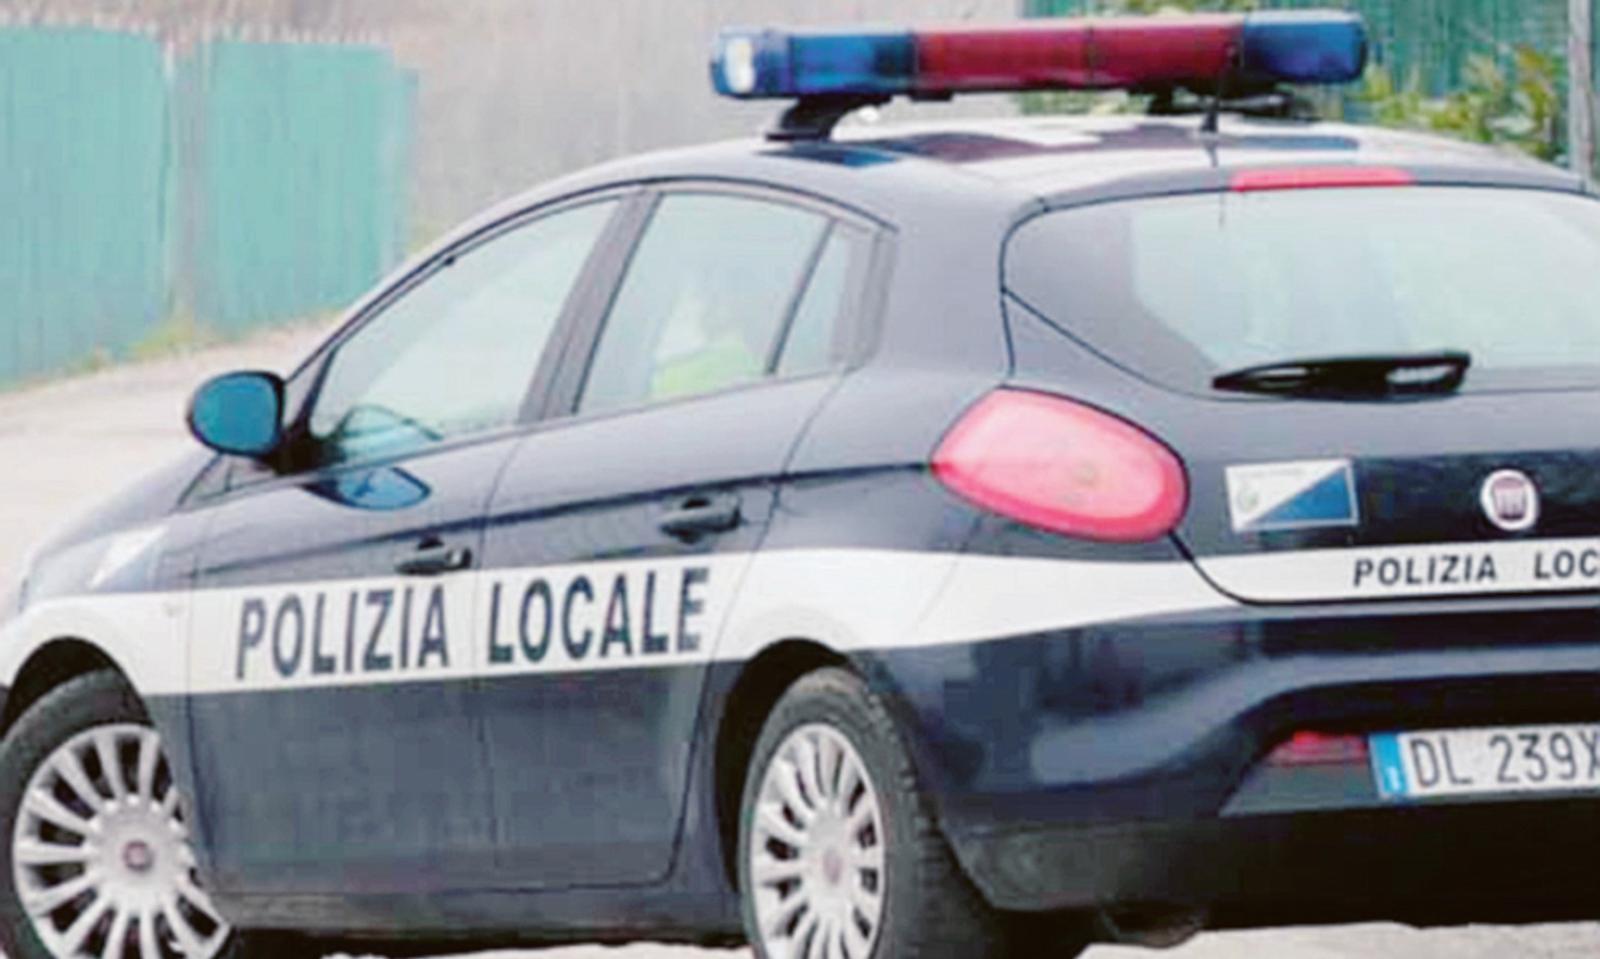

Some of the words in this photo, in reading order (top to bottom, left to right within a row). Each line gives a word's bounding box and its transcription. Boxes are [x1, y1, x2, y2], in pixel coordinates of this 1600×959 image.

[1353, 555, 1496, 586] POLIZIA
[1534, 550, 1600, 579] LOC
[236, 585, 448, 679] POLIZIA
[487, 568, 710, 664] LOCALE
[1410, 735, 1474, 787] DL
